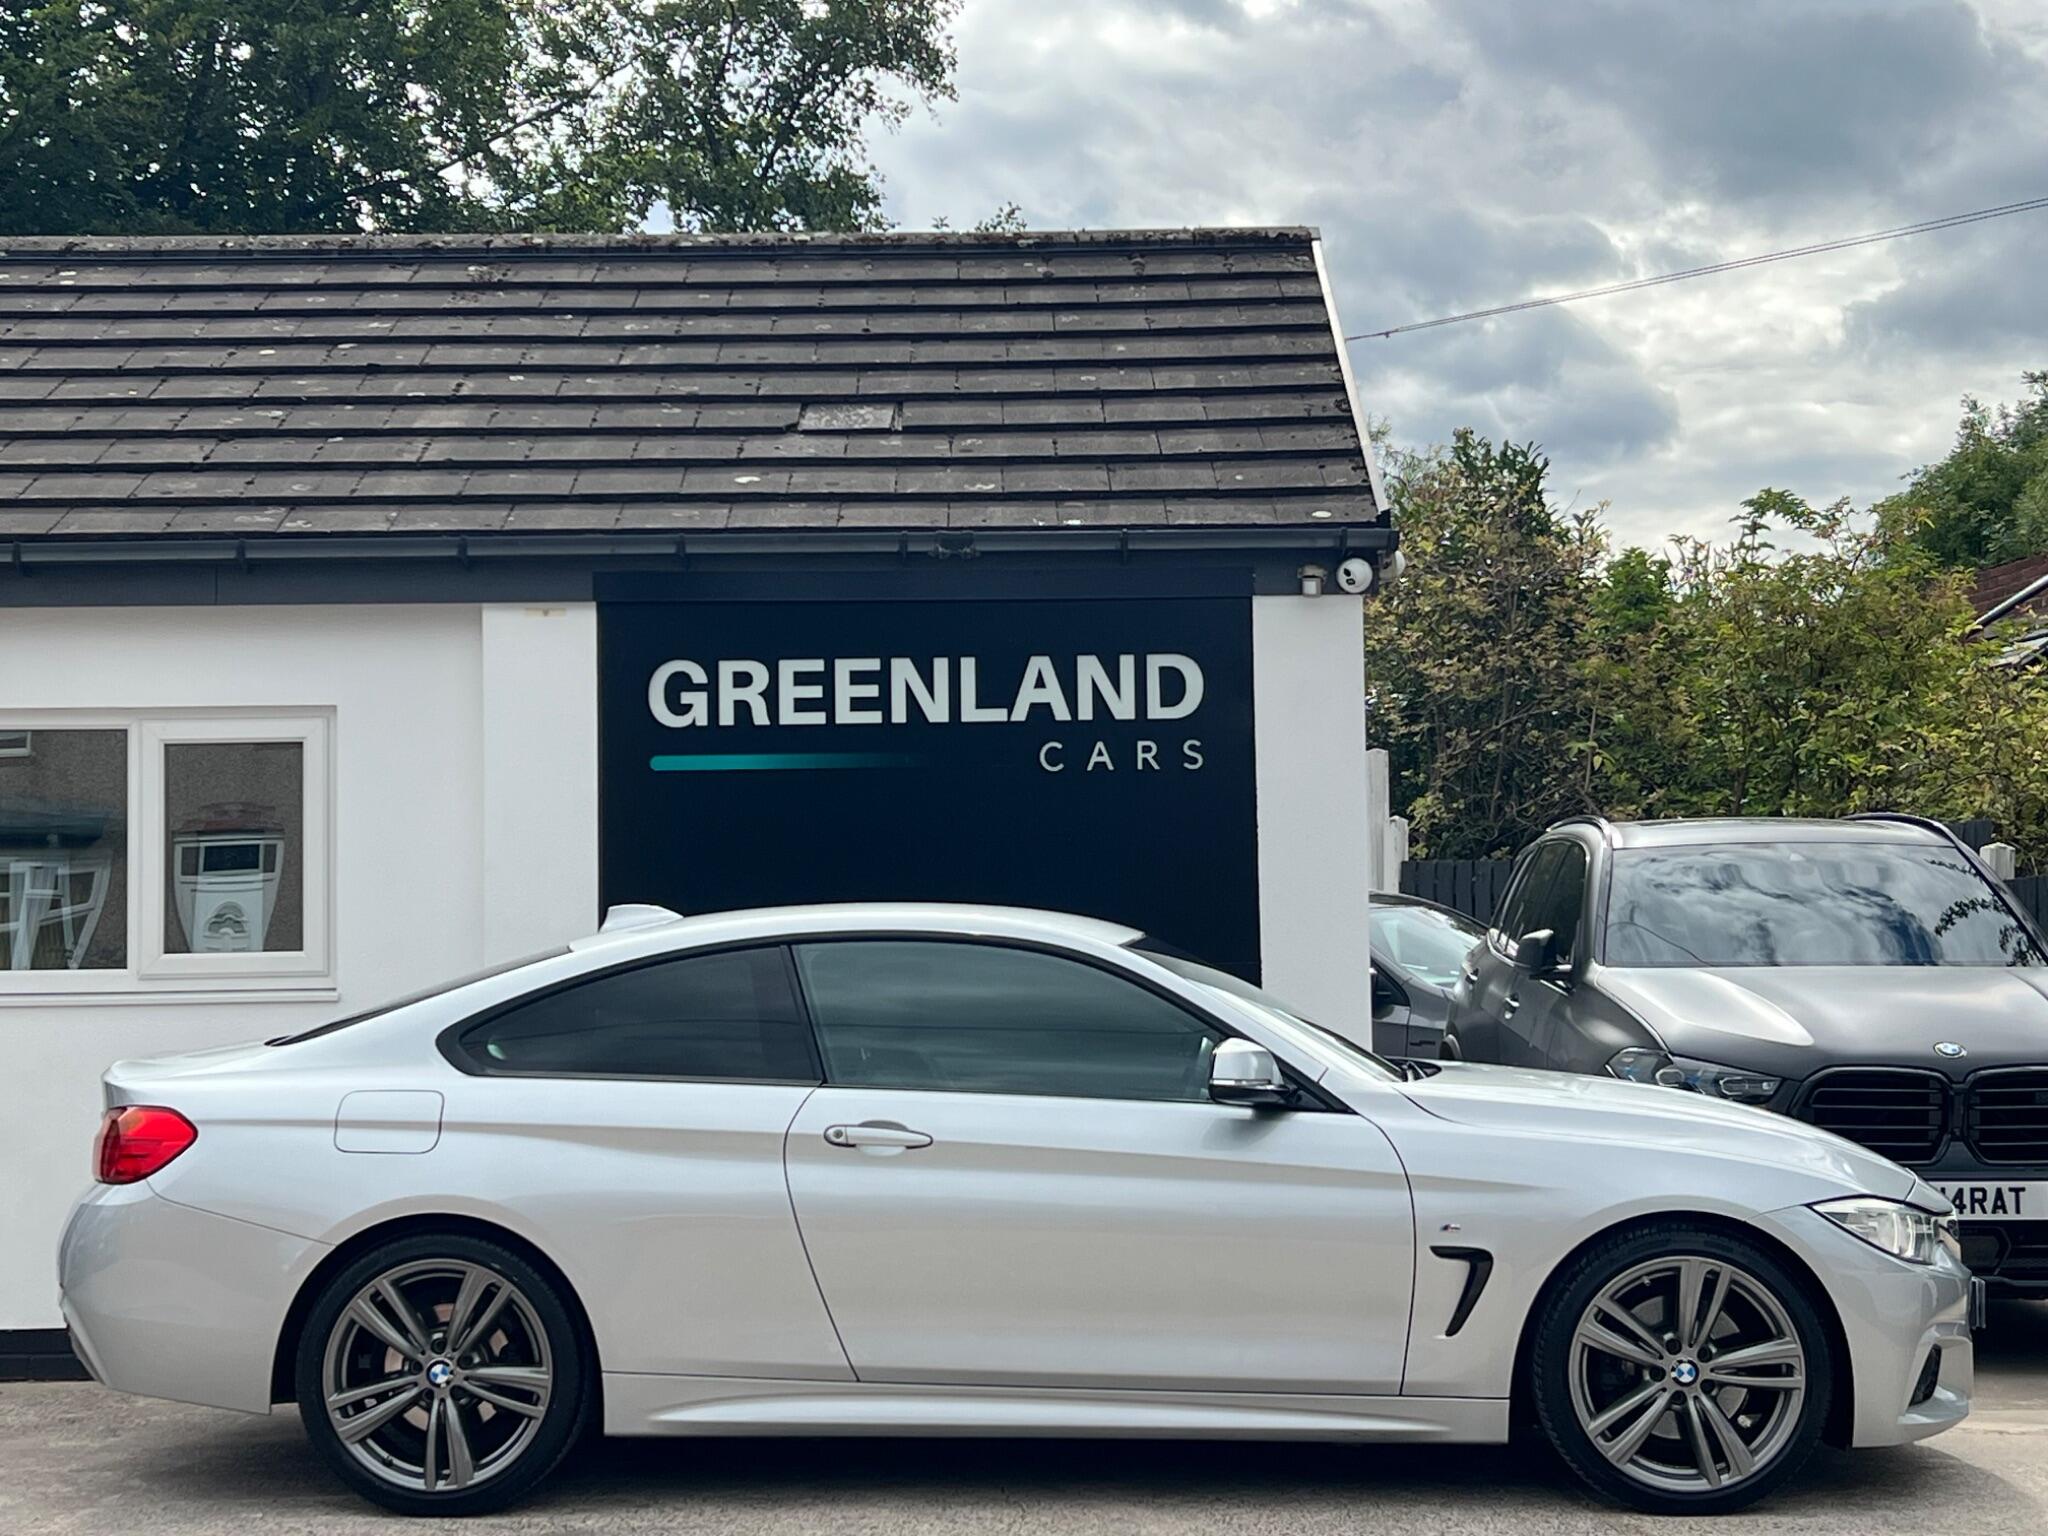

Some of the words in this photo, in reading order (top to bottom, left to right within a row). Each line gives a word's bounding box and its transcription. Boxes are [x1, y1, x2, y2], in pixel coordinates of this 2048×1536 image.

[648, 653, 1204, 728] GREENLAND
[1039, 740, 1204, 772] CARS
[1940, 1187, 2026, 1215] 4RAT
